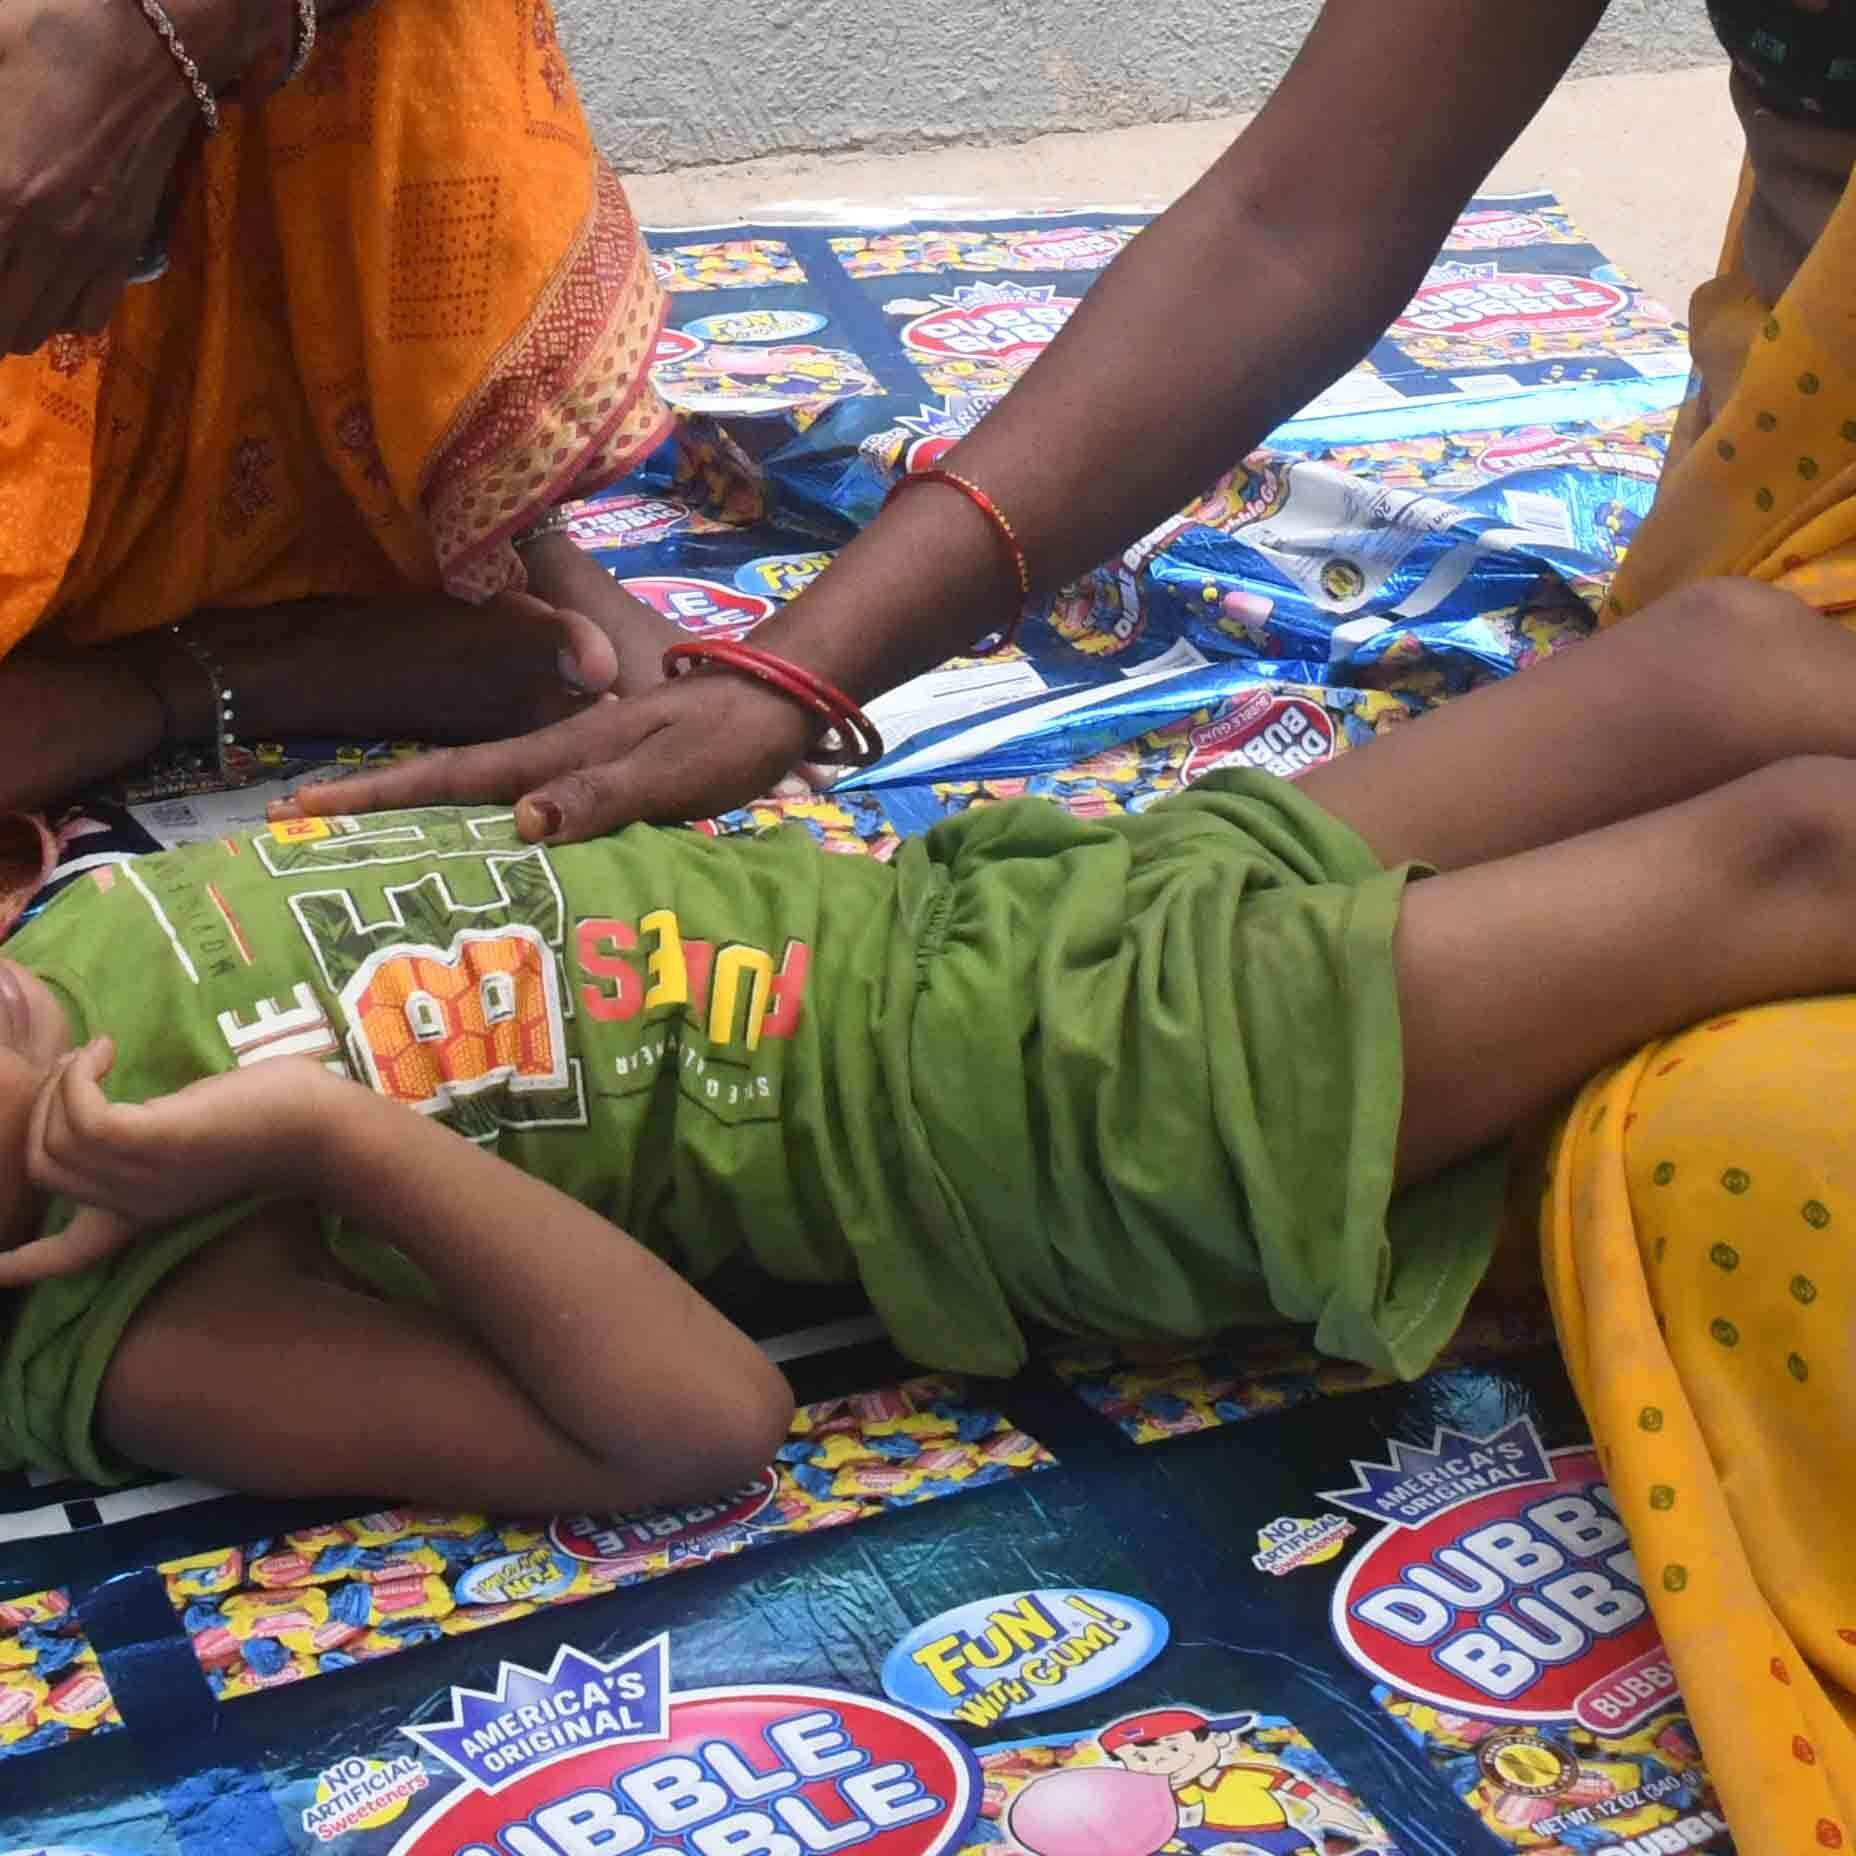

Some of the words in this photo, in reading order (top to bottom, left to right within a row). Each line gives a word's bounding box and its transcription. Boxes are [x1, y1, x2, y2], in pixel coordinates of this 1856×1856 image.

[923, 307, 1070, 337] DUBB
[1410, 293, 1613, 329] BUBBLE
[1264, 727, 1328, 777] DUB
[1375, 1442, 1526, 1512] AMERICA'S
[1399, 1462, 1533, 1518] ORIGINAL
[1255, 1513, 1346, 1571] ARTIFICIAL
[1262, 1517, 1299, 1544] NO
[1270, 1523, 1357, 1576] Sweeteners
[1352, 1485, 1631, 1645] DUBB
[911, 1593, 1066, 1697] FUN
[1434, 1550, 1647, 1699] BUB
[952, 1677, 1034, 1729] WITH
[1020, 1594, 1131, 1688] GUM!
[1590, 1661, 1673, 1719] BUBB
[460, 1671, 646, 1758] AMERICA'S
[482, 1704, 644, 1772] ORIGINAL
[305, 1755, 419, 1829] ARTIFICIAL
[323, 1758, 366, 1793] NO
[317, 1772, 429, 1841] Sweeteners
[1532, 1814, 1568, 1836] NET
[1596, 1798, 1621, 1817] 12
[1617, 1790, 1645, 1809] OZ
